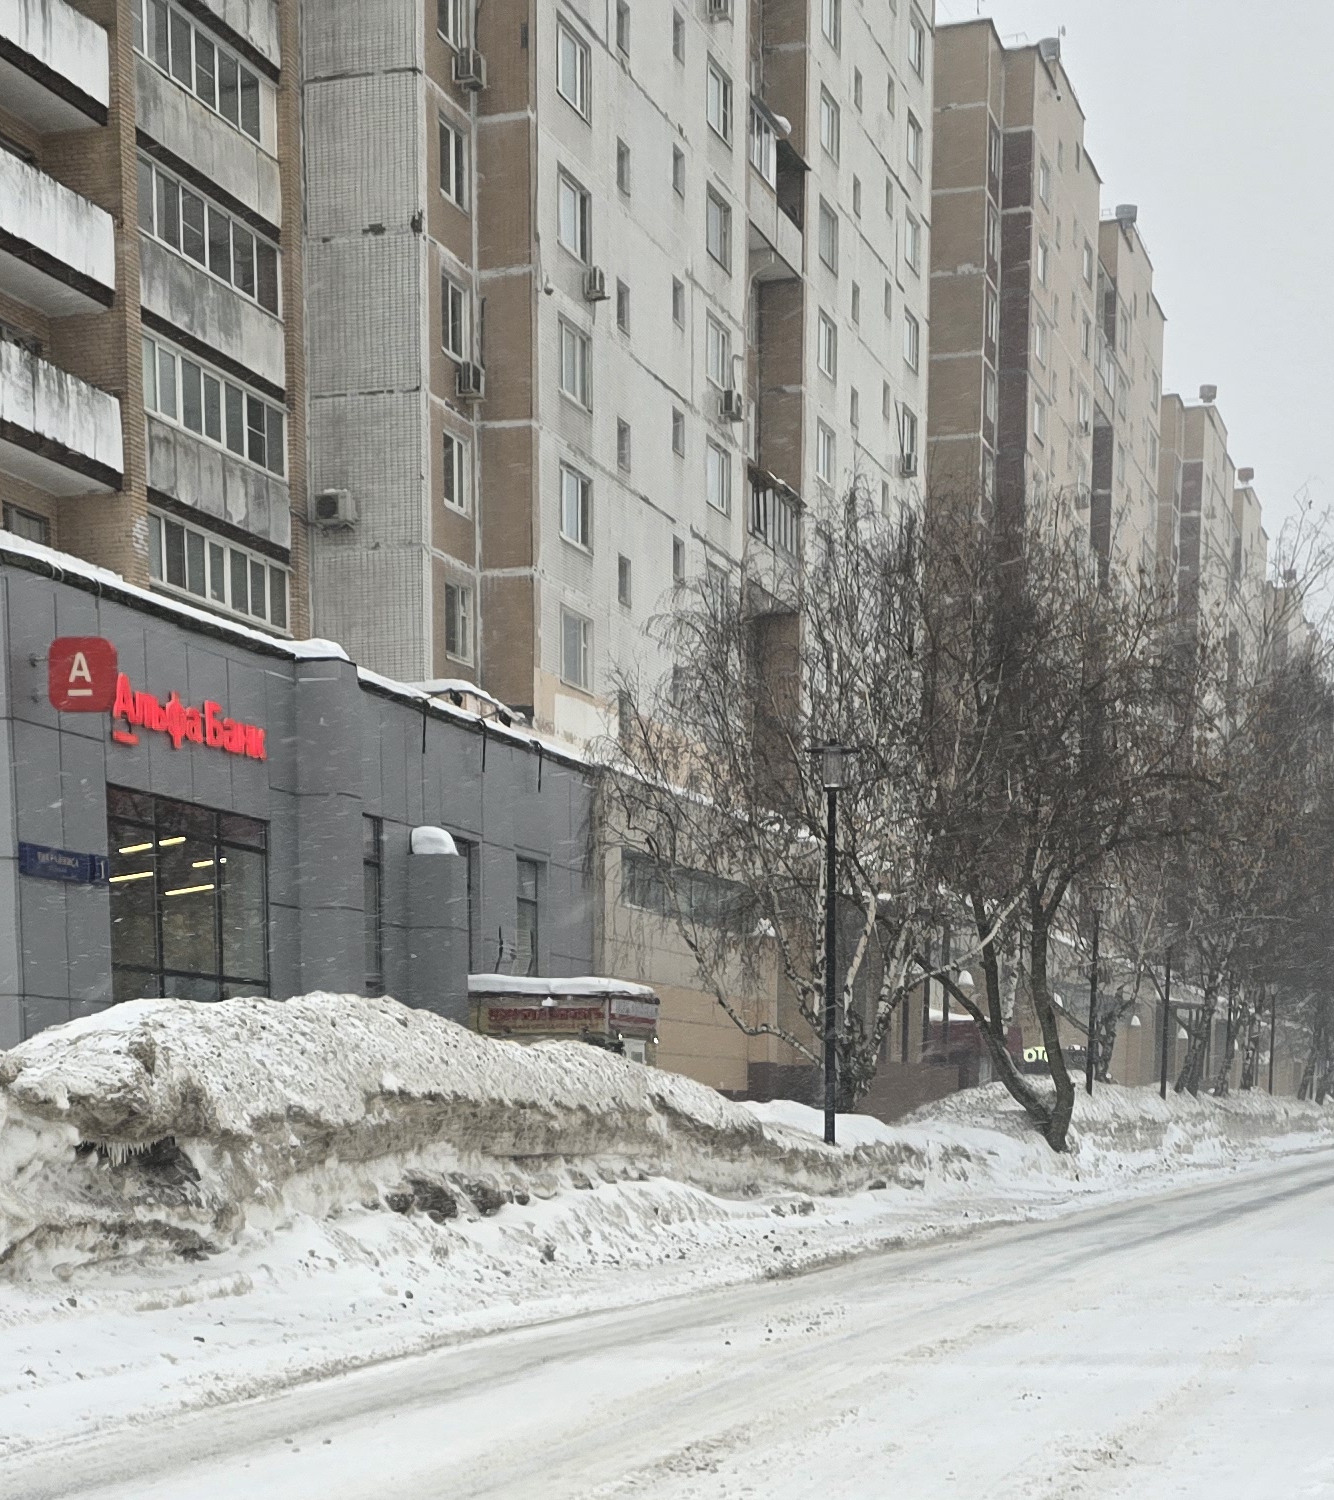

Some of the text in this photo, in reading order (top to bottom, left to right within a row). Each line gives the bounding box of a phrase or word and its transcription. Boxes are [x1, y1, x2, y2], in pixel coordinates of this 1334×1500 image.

[68, 652, 92, 683] А
[112, 672, 268, 761] Альфа Банк
